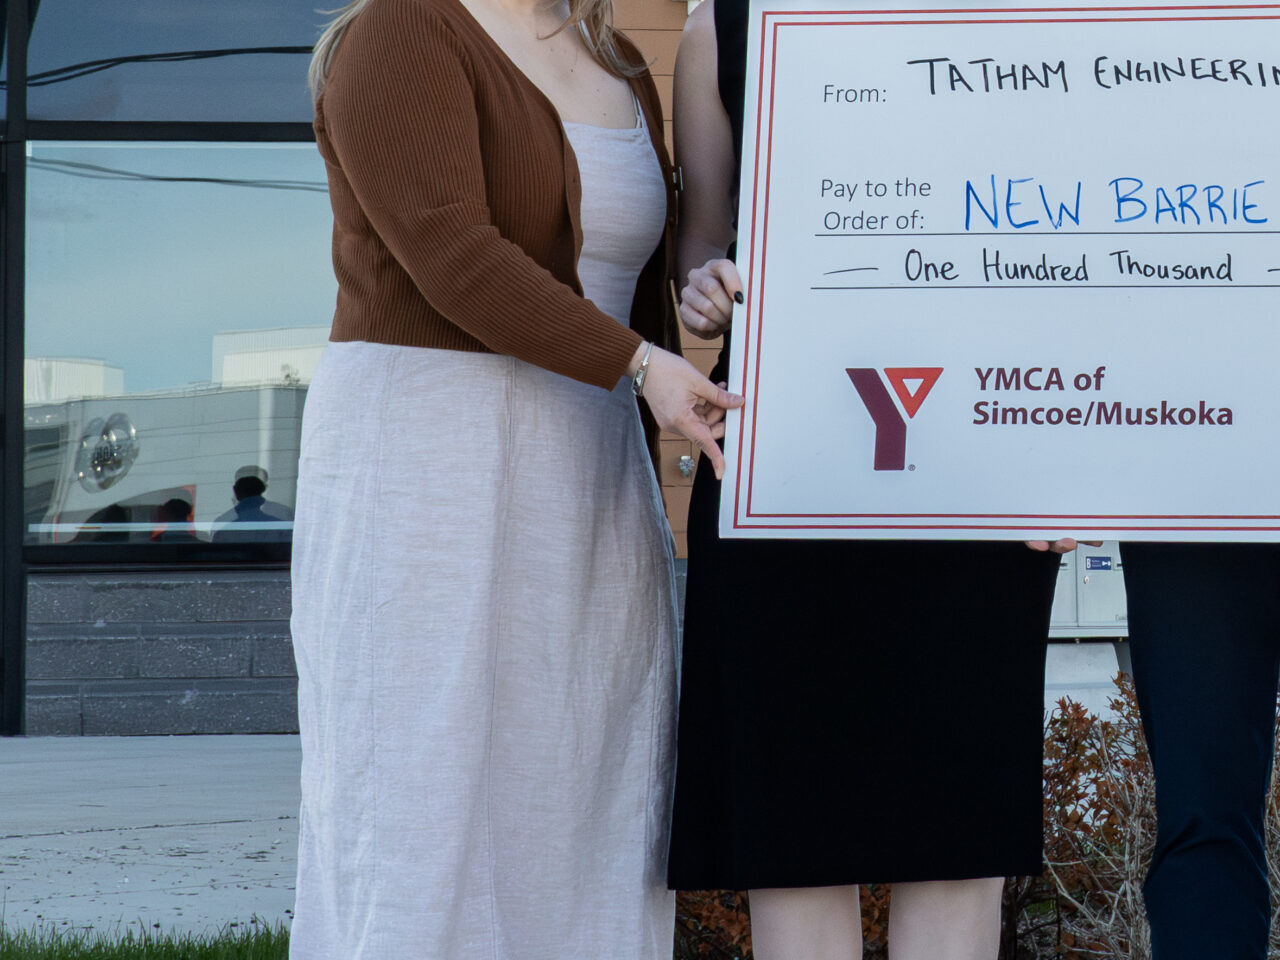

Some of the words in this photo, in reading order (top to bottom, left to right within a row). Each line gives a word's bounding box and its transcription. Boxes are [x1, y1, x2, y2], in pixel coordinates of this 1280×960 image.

[907, 57, 1069, 95] TATHAM
[823, 84, 887, 103] From:
[821, 178, 859, 203] Pay
[865, 179, 888, 198] to
[894, 177, 932, 197] the
[964, 174, 1083, 232] NEW
[1109, 176, 1269, 226] BARRIE
[823, 209, 889, 231] Order
[895, 209, 925, 230] of:
[904, 248, 960, 282] One
[982, 247, 1089, 283] Hundred
[1108, 249, 1234, 282] Thousand
[974, 366, 1065, 392] YMCA
[1073, 365, 1107, 392] of
[972, 400, 1234, 427] Simcoe/Muskoka
